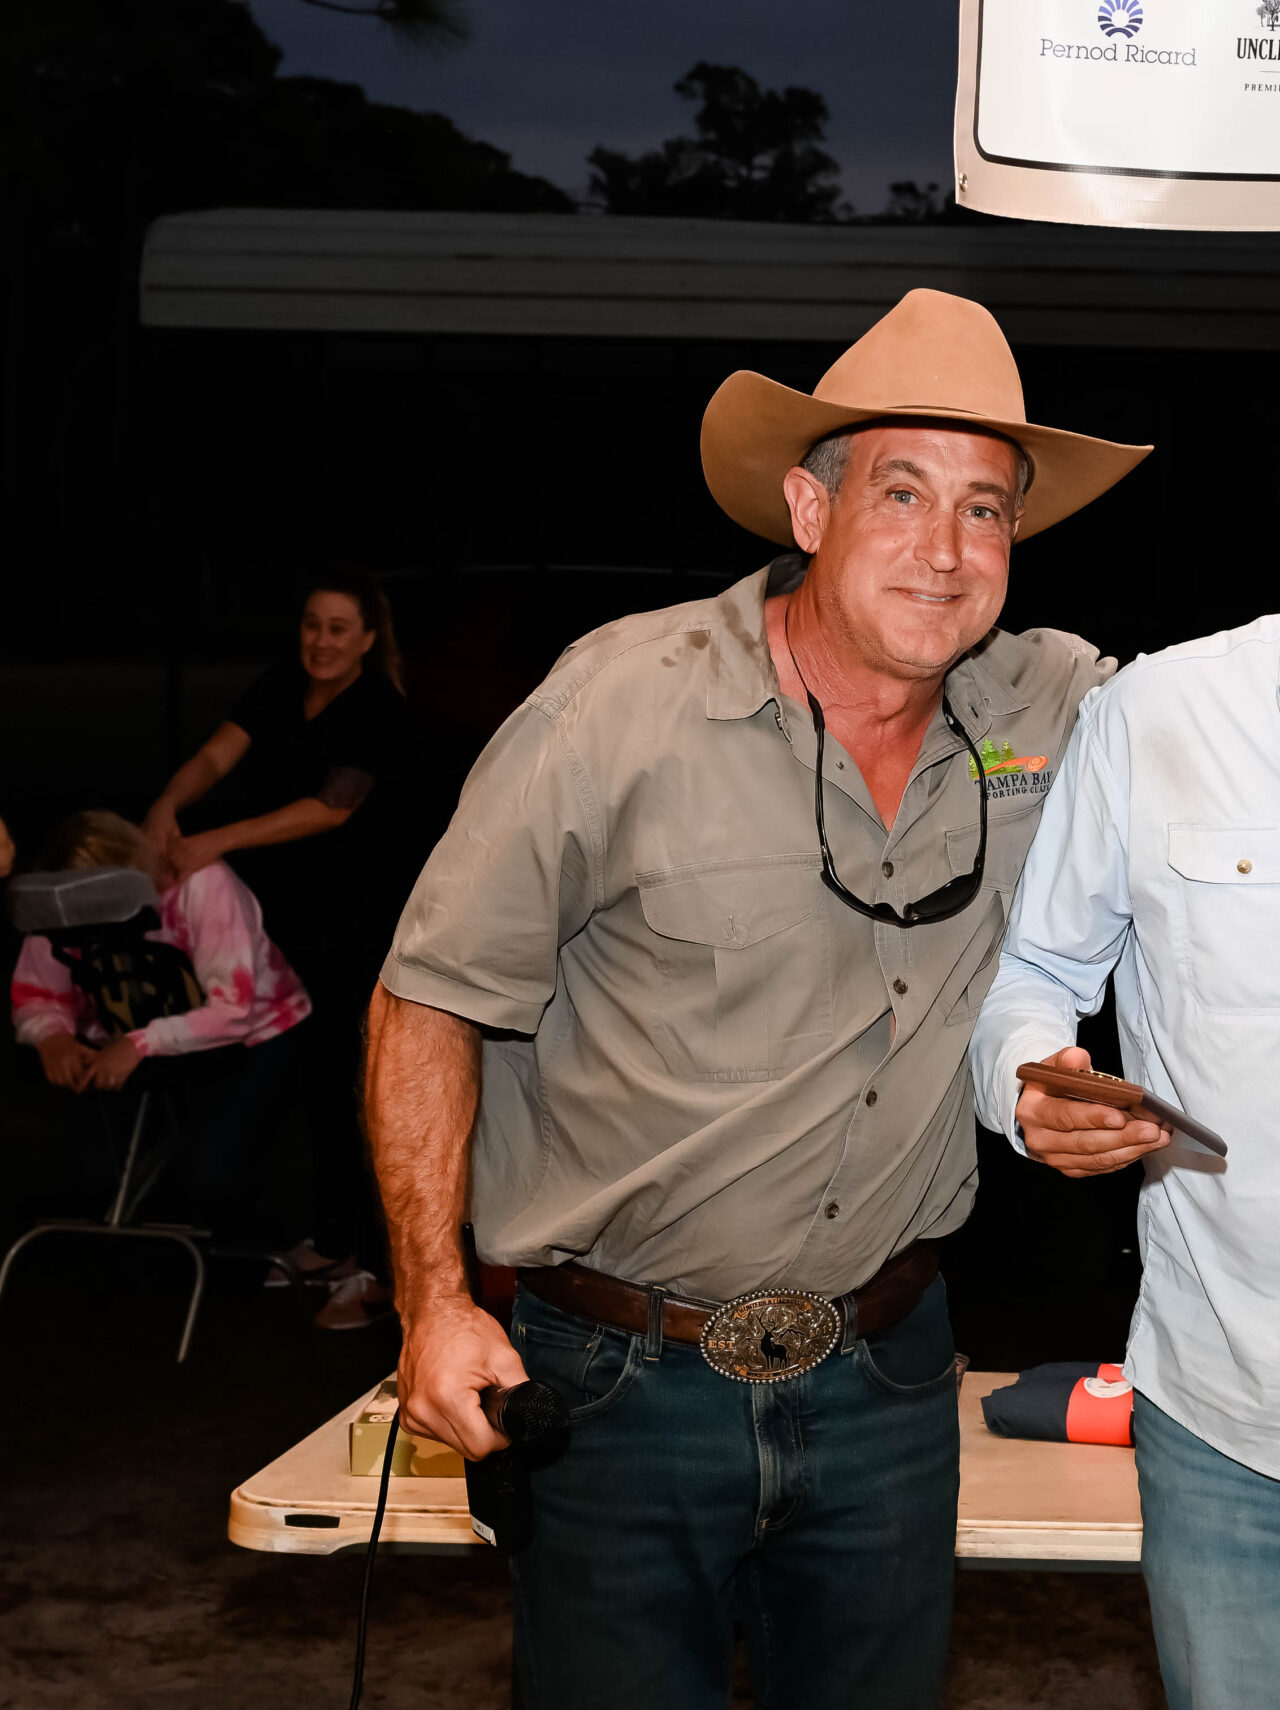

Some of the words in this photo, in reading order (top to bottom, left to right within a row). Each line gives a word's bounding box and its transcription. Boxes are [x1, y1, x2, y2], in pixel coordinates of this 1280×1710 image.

[1040, 38, 1118, 62] Pernod
[1125, 44, 1197, 66] Ricard
[975, 773, 1028, 791] AMPA
[1032, 770, 1053, 786] BAY
[985, 786, 1028, 800] PORTING
